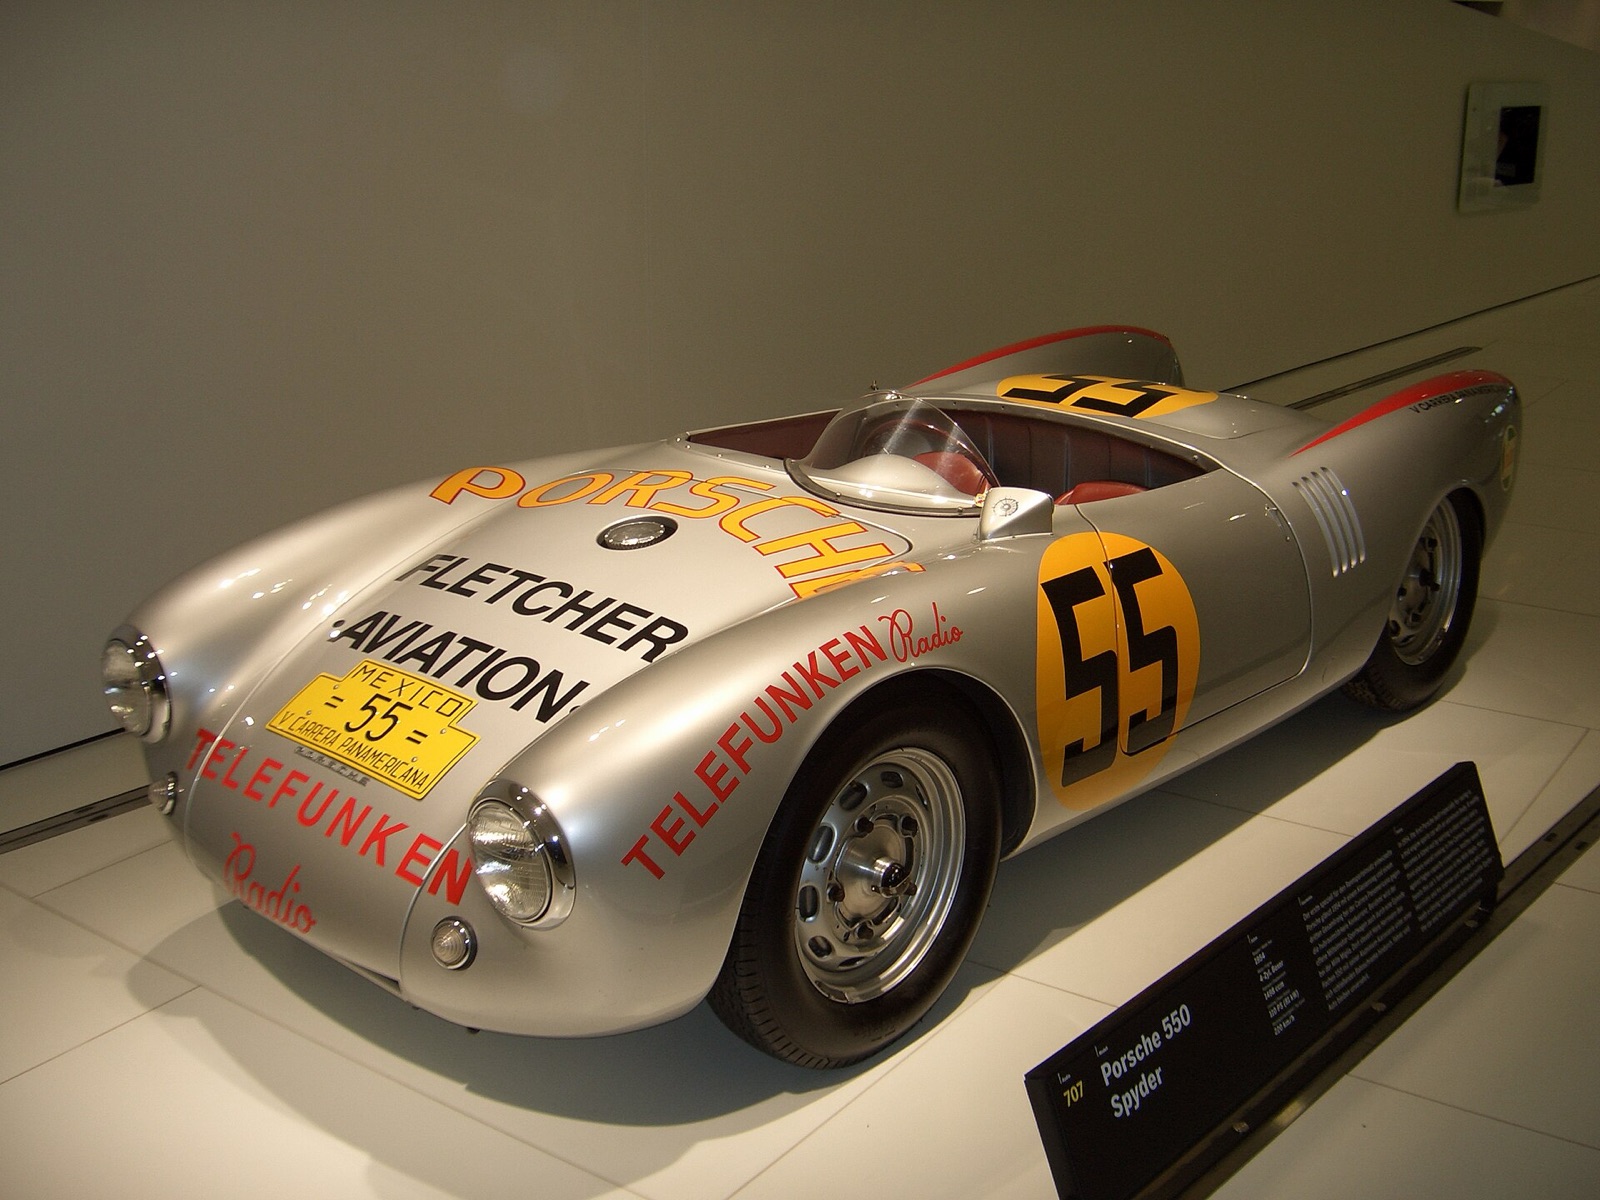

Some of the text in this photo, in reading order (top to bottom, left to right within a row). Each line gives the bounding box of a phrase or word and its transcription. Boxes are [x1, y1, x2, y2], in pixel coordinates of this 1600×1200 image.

[395, 554, 690, 664] FLETCHER
[351, 664, 464, 718] MEXICO
[1040, 547, 1179, 788] 55
[278, 710, 431, 790] V CARRERA PANAMERICANA
[620, 601, 964, 880] TELEFUNKEN Radio
[185, 727, 473, 907] TELEFUNKEN
[222, 831, 317, 935] Radio
[1100, 1004, 1191, 1087] Porsche 550
[1110, 1066, 1163, 1118] Spyder
[1063, 1080, 1084, 1108] 707
